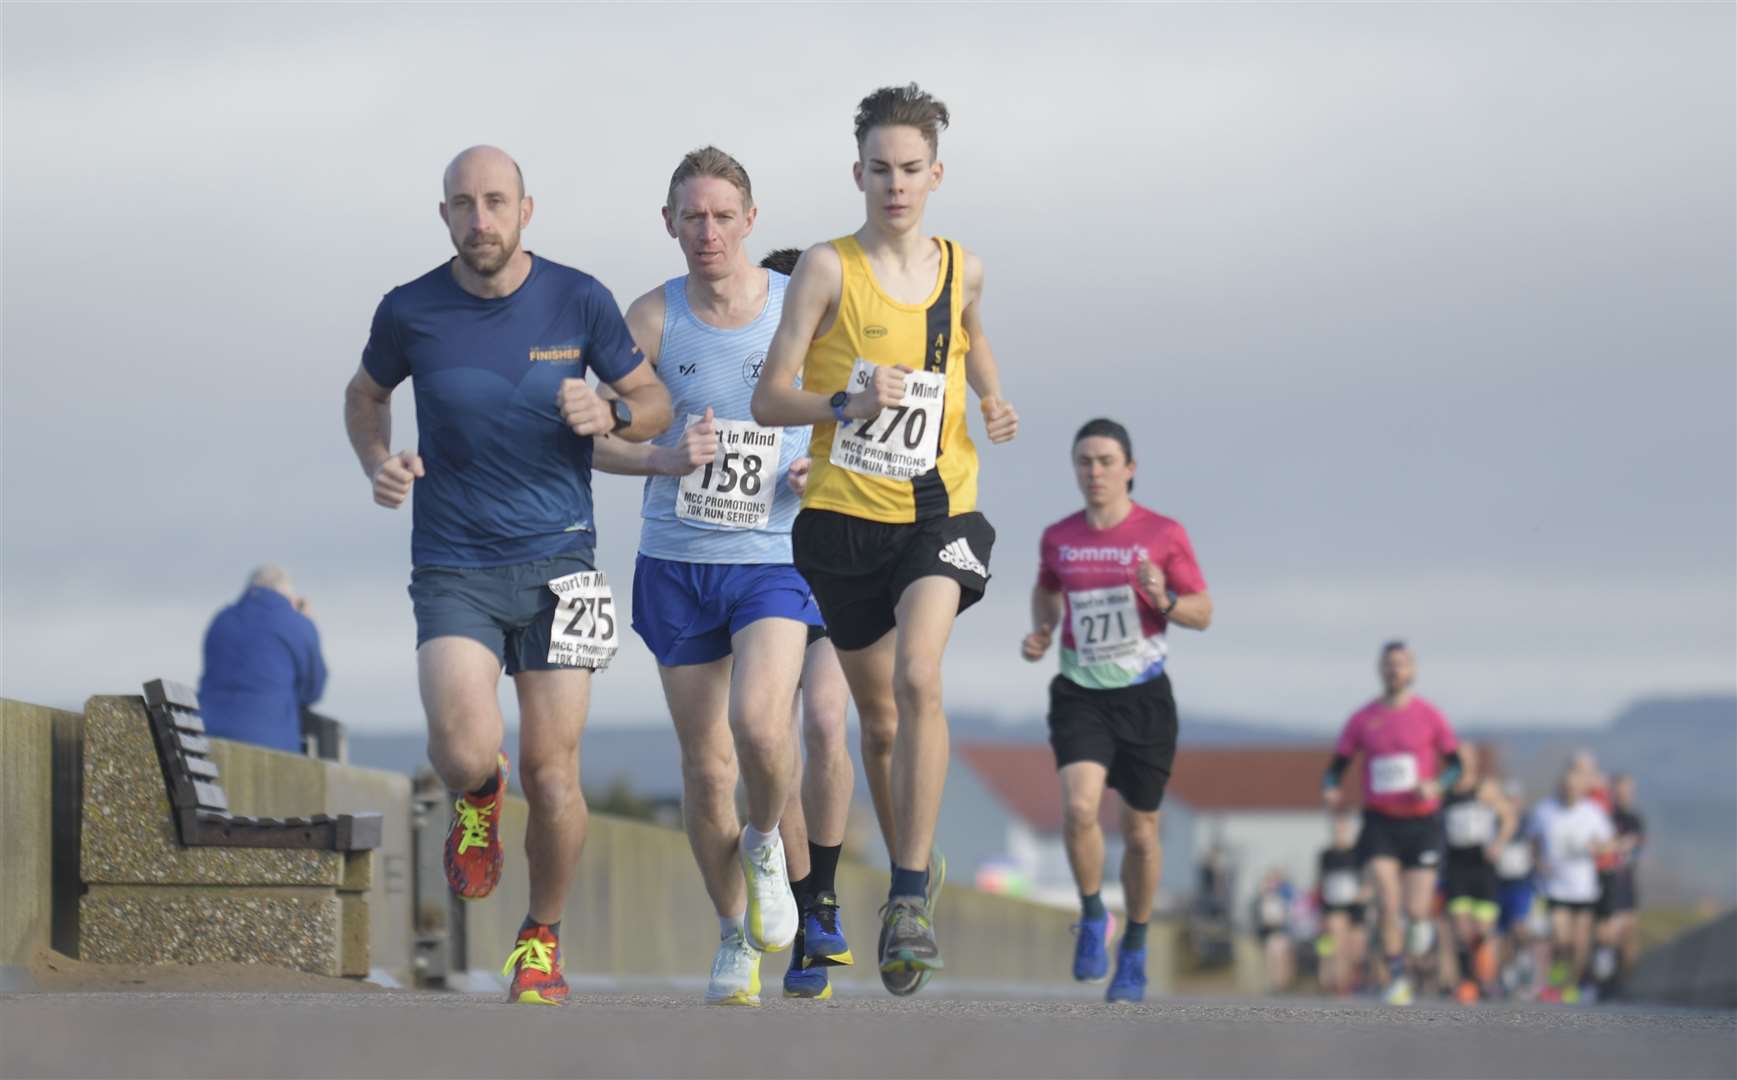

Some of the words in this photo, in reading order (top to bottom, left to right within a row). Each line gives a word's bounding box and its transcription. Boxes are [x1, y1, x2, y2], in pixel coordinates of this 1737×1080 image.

[529, 347, 581, 360] FINISHER
[911, 382, 939, 399] Mind
[727, 430, 739, 444] in
[743, 431, 775, 446] Mind
[854, 406, 927, 450] 270
[841, 440, 863, 454] MCC
[864, 447, 927, 467] PROMOTIONS
[844, 454, 861, 466] 10K
[861, 459, 882, 473] RUN
[701, 453, 762, 496] 158
[684, 492, 703, 504] MCC
[705, 496, 766, 514] PROMOTIONS
[687, 505, 704, 516] 10K
[704, 508, 724, 519] RUN
[727, 511, 760, 524] SERIES
[1059, 544, 1148, 565] Tommy's
[563, 597, 614, 641] 275
[1081, 611, 1127, 643] 271
[550, 641, 573, 652] MCC
